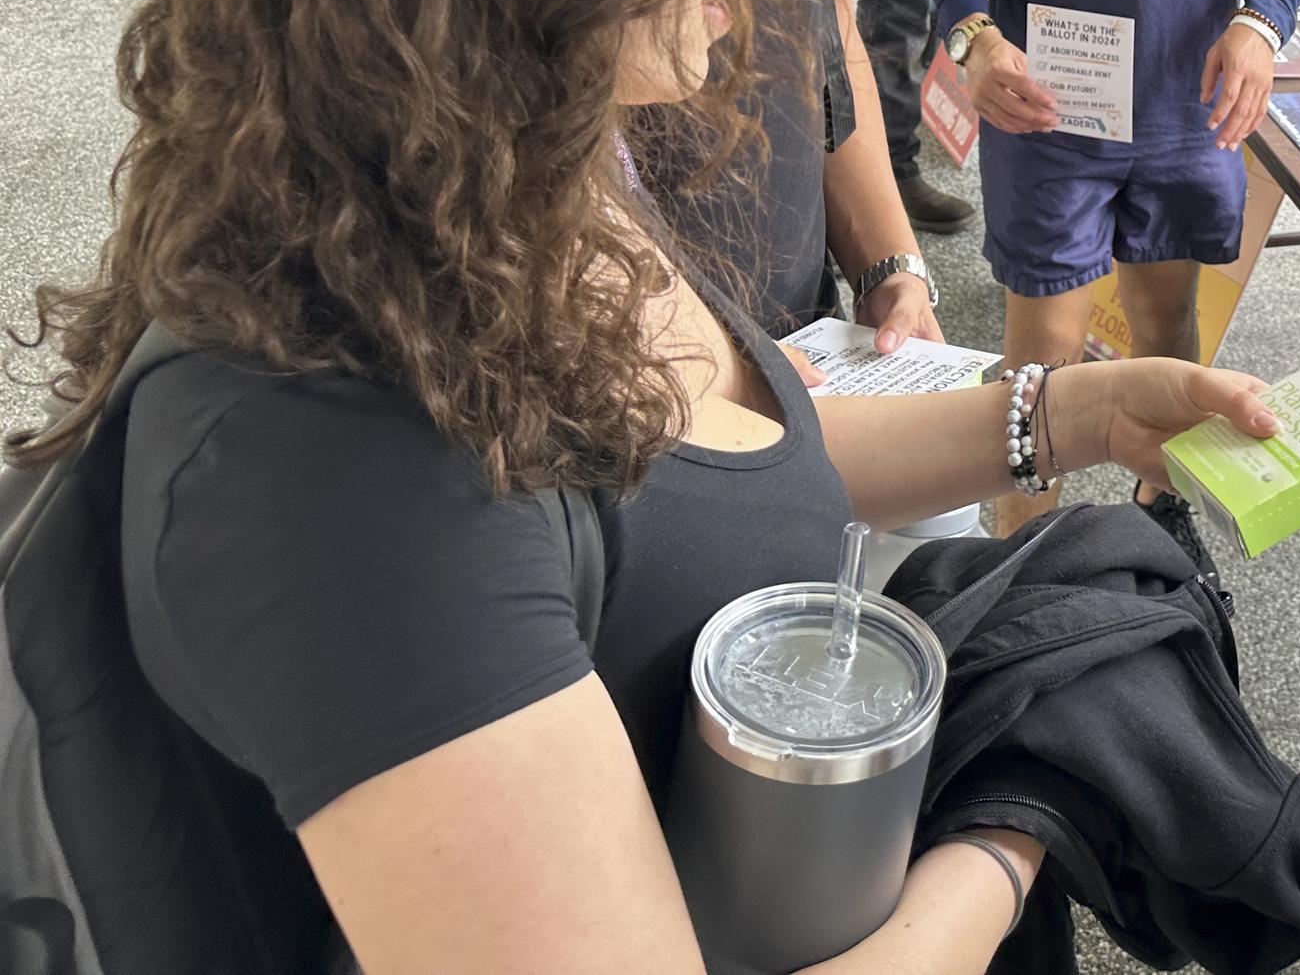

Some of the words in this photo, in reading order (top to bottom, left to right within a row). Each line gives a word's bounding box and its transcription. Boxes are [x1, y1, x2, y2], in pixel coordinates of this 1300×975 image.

[1045, 18, 1080, 32] WHAT'S
[1082, 24, 1097, 34] ON
[1101, 27, 1117, 37] THE
[1041, 28, 1076, 41] BALLOT
[1080, 33, 1089, 42] IN
[1092, 35, 1121, 46] 2024?
[1050, 46, 1088, 58] ABORTION
[1090, 52, 1119, 62] ACCESS
[1050, 65, 1092, 77] AFFORDABLE
[1050, 82, 1065, 90] OUR
[1060, 117, 1097, 130] EADERS
[1088, 303, 1132, 346] FLORI
